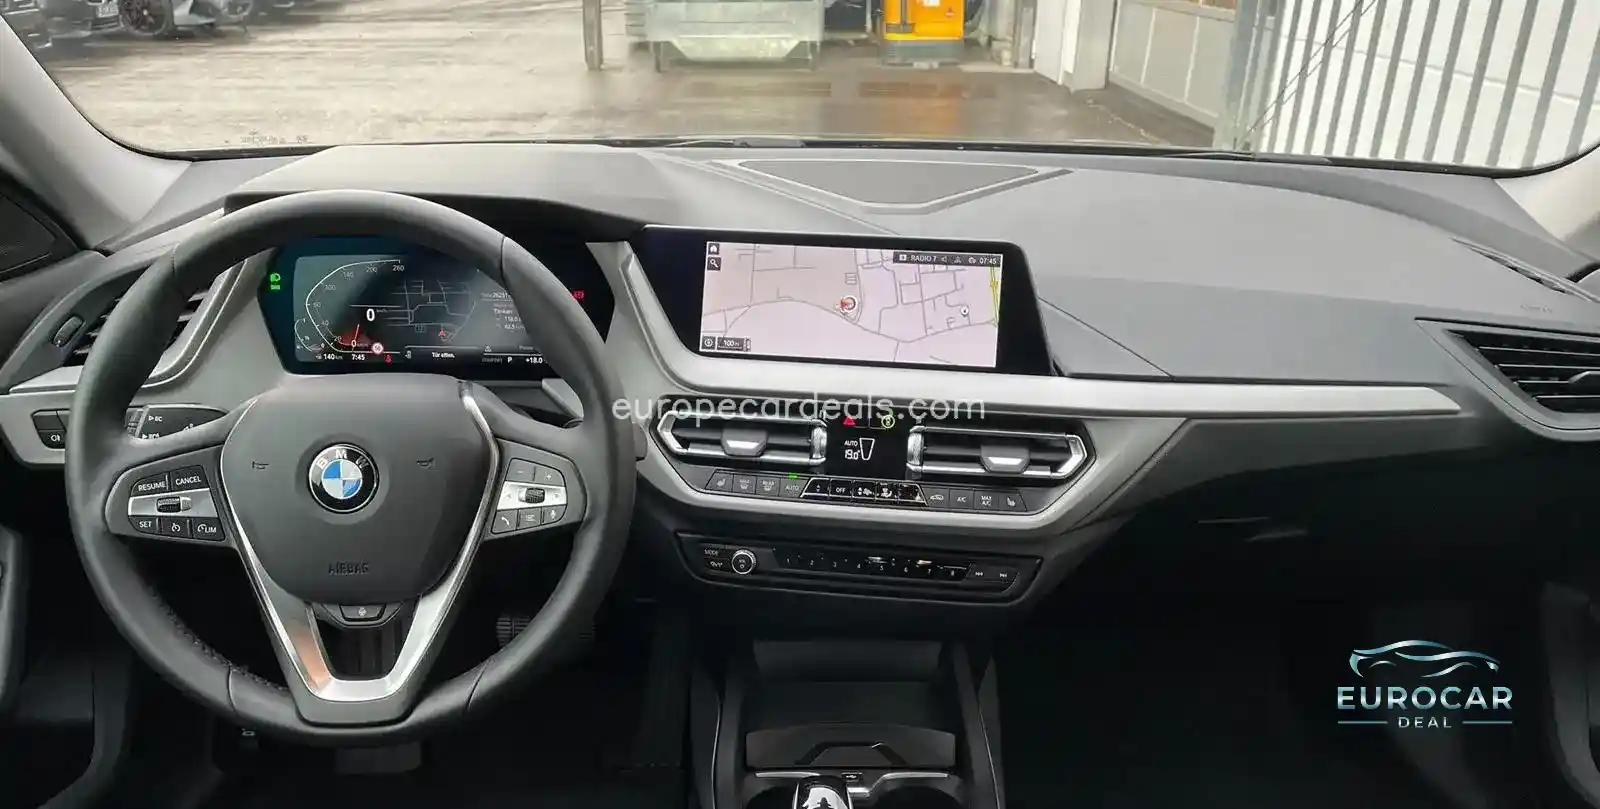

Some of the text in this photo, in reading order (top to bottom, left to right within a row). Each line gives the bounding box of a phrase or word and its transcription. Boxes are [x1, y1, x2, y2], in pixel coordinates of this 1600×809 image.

[979, 257, 997, 265] 07:45
[366, 308, 375, 321] 0
[316, 448, 369, 470] BMW
[138, 480, 166, 492] RESUME
[175, 475, 202, 486] CANCEL
[835, 486, 846, 494] OFF
